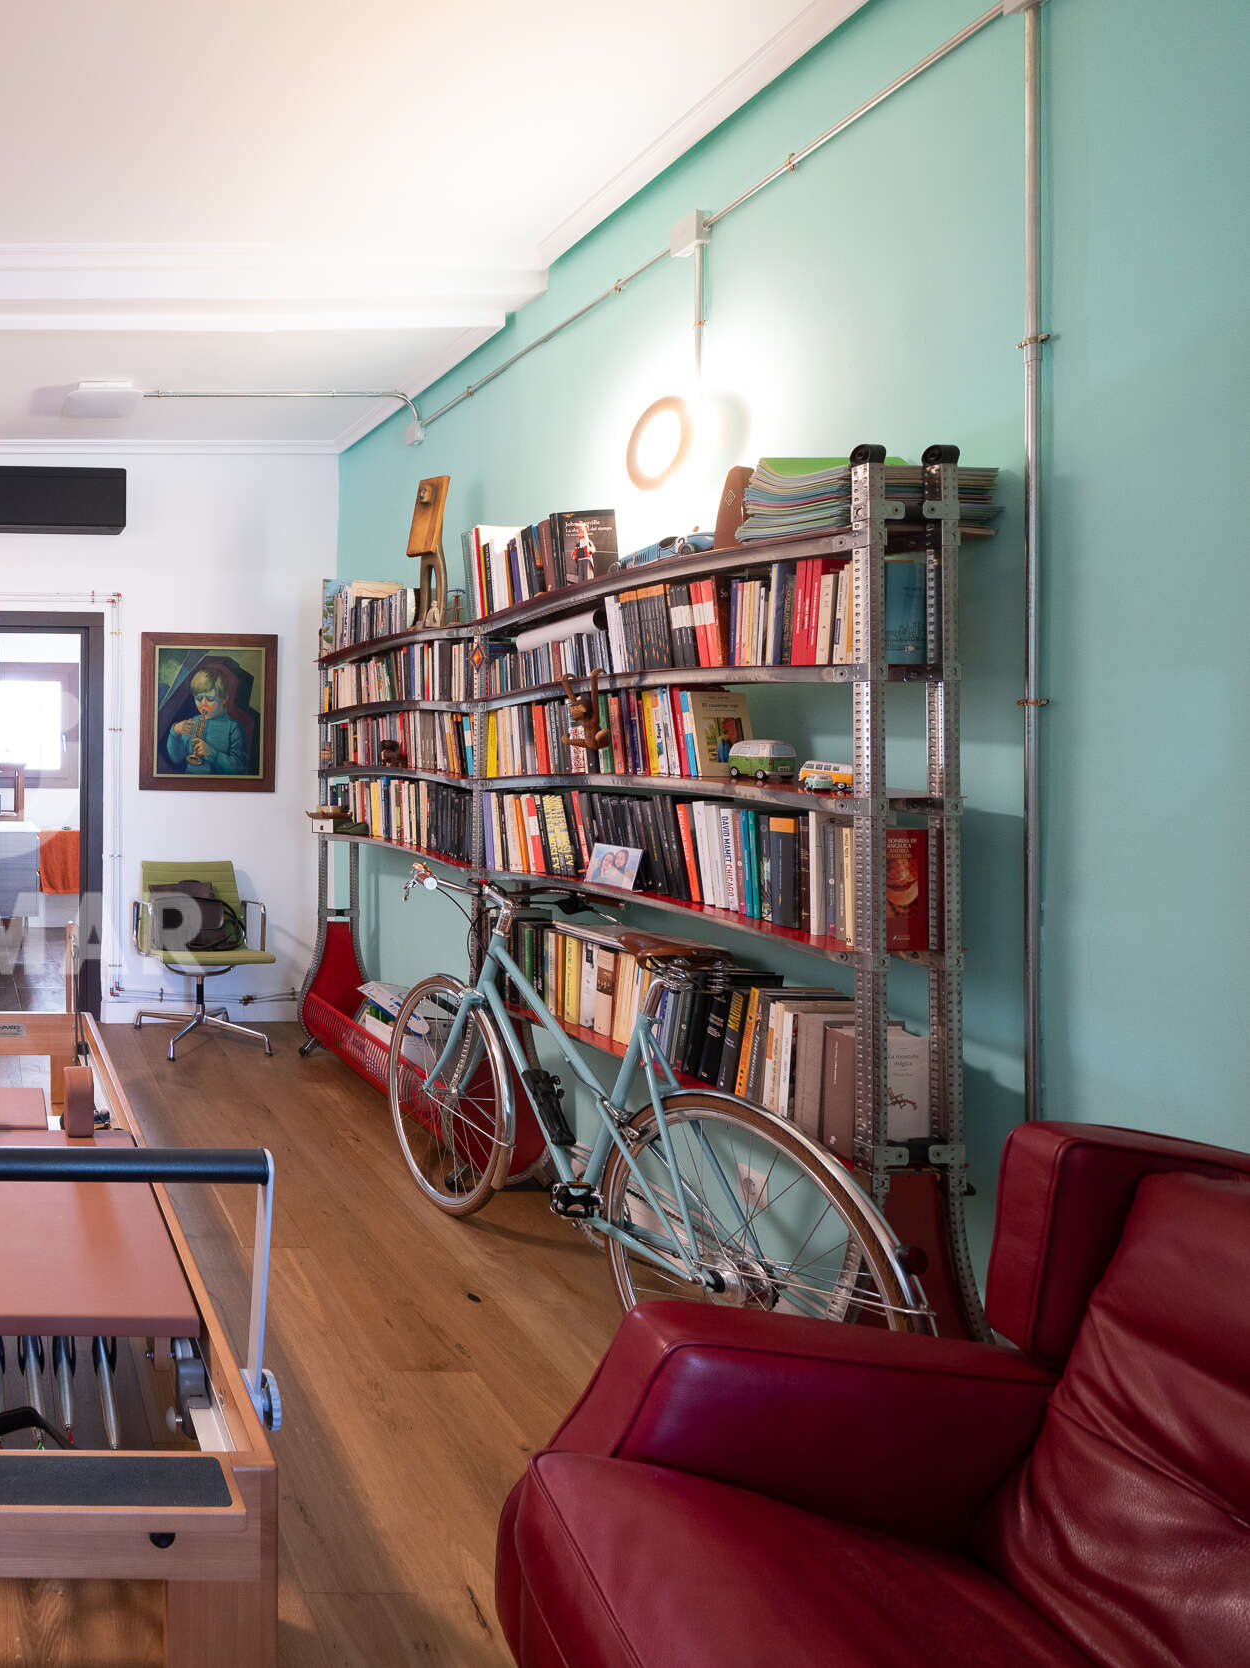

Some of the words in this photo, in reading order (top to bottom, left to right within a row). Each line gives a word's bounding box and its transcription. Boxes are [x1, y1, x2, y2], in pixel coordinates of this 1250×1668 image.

[721, 815, 730, 837] DAVID
[723, 838, 732, 863] MAMET
[725, 864, 735, 897] CHICAGO
[726, 991, 743, 1032] MADRID
